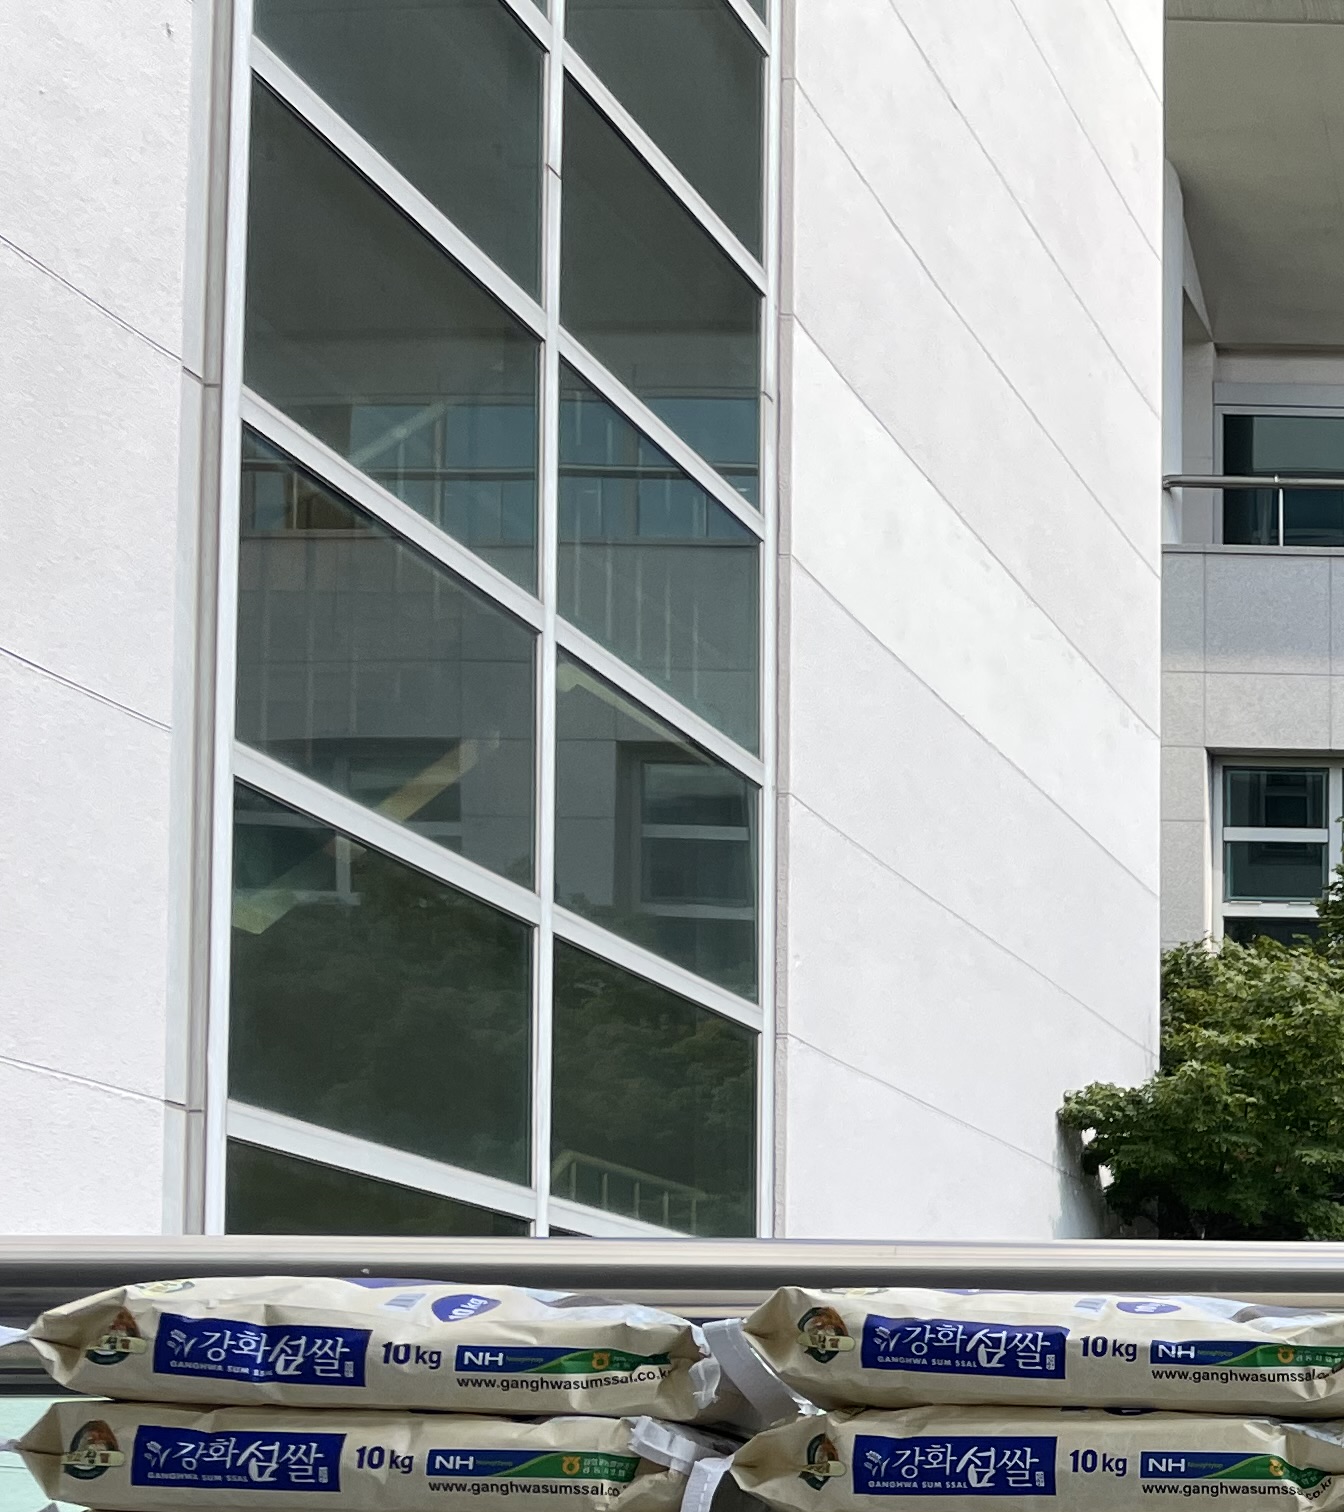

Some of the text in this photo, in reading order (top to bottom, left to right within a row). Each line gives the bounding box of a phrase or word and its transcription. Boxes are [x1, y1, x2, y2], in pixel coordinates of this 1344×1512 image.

[192, 1330, 352, 1377] 강화섬쌀
[464, 1351, 504, 1366] NH
[877, 1356, 978, 1368] GANGHWA SUM SSAL
[903, 1324, 1050, 1369] 강화섬쌀
[1158, 1344, 1195, 1359] NH
[173, 1438, 328, 1483] 강화섬쌀
[434, 1455, 474, 1470] NH
